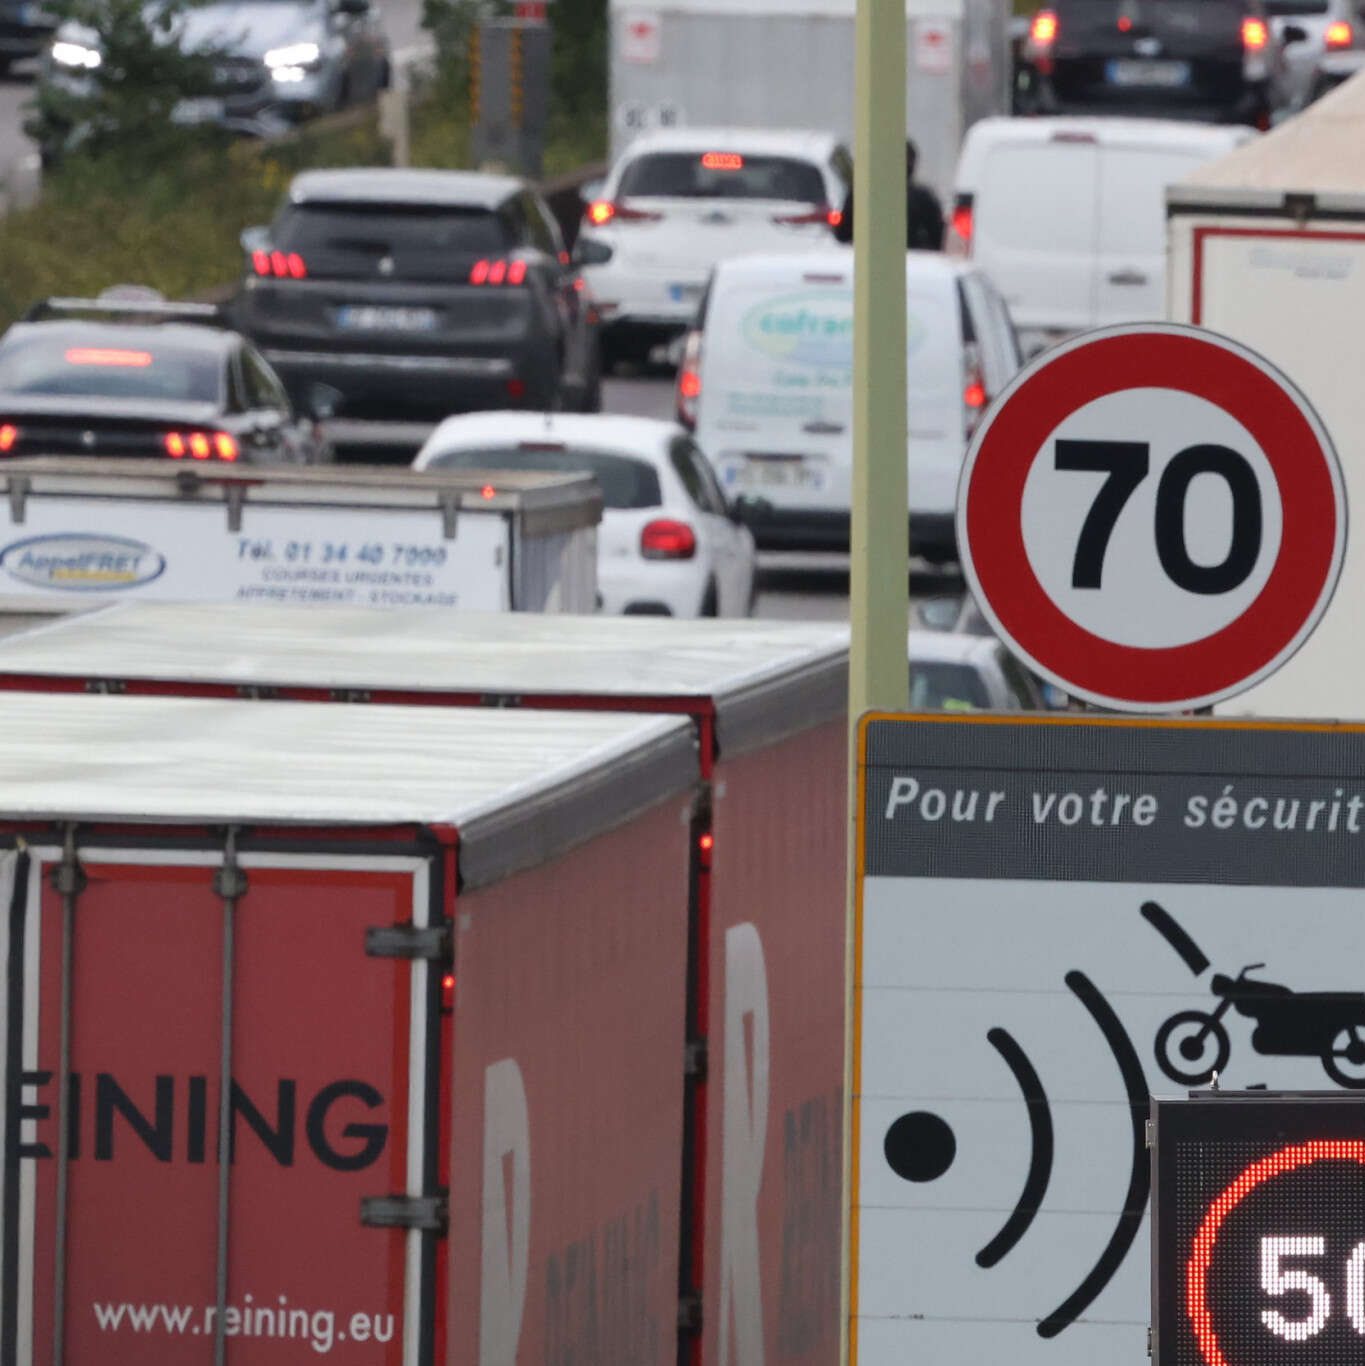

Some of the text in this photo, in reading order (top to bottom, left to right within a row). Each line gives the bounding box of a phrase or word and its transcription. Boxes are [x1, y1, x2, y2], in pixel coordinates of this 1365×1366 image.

[1054, 439, 1263, 595] 70
[885, 777, 1005, 822] Pour
[1032, 787, 1158, 826] votre
[94, 1294, 394, 1353] www.reining.eu
